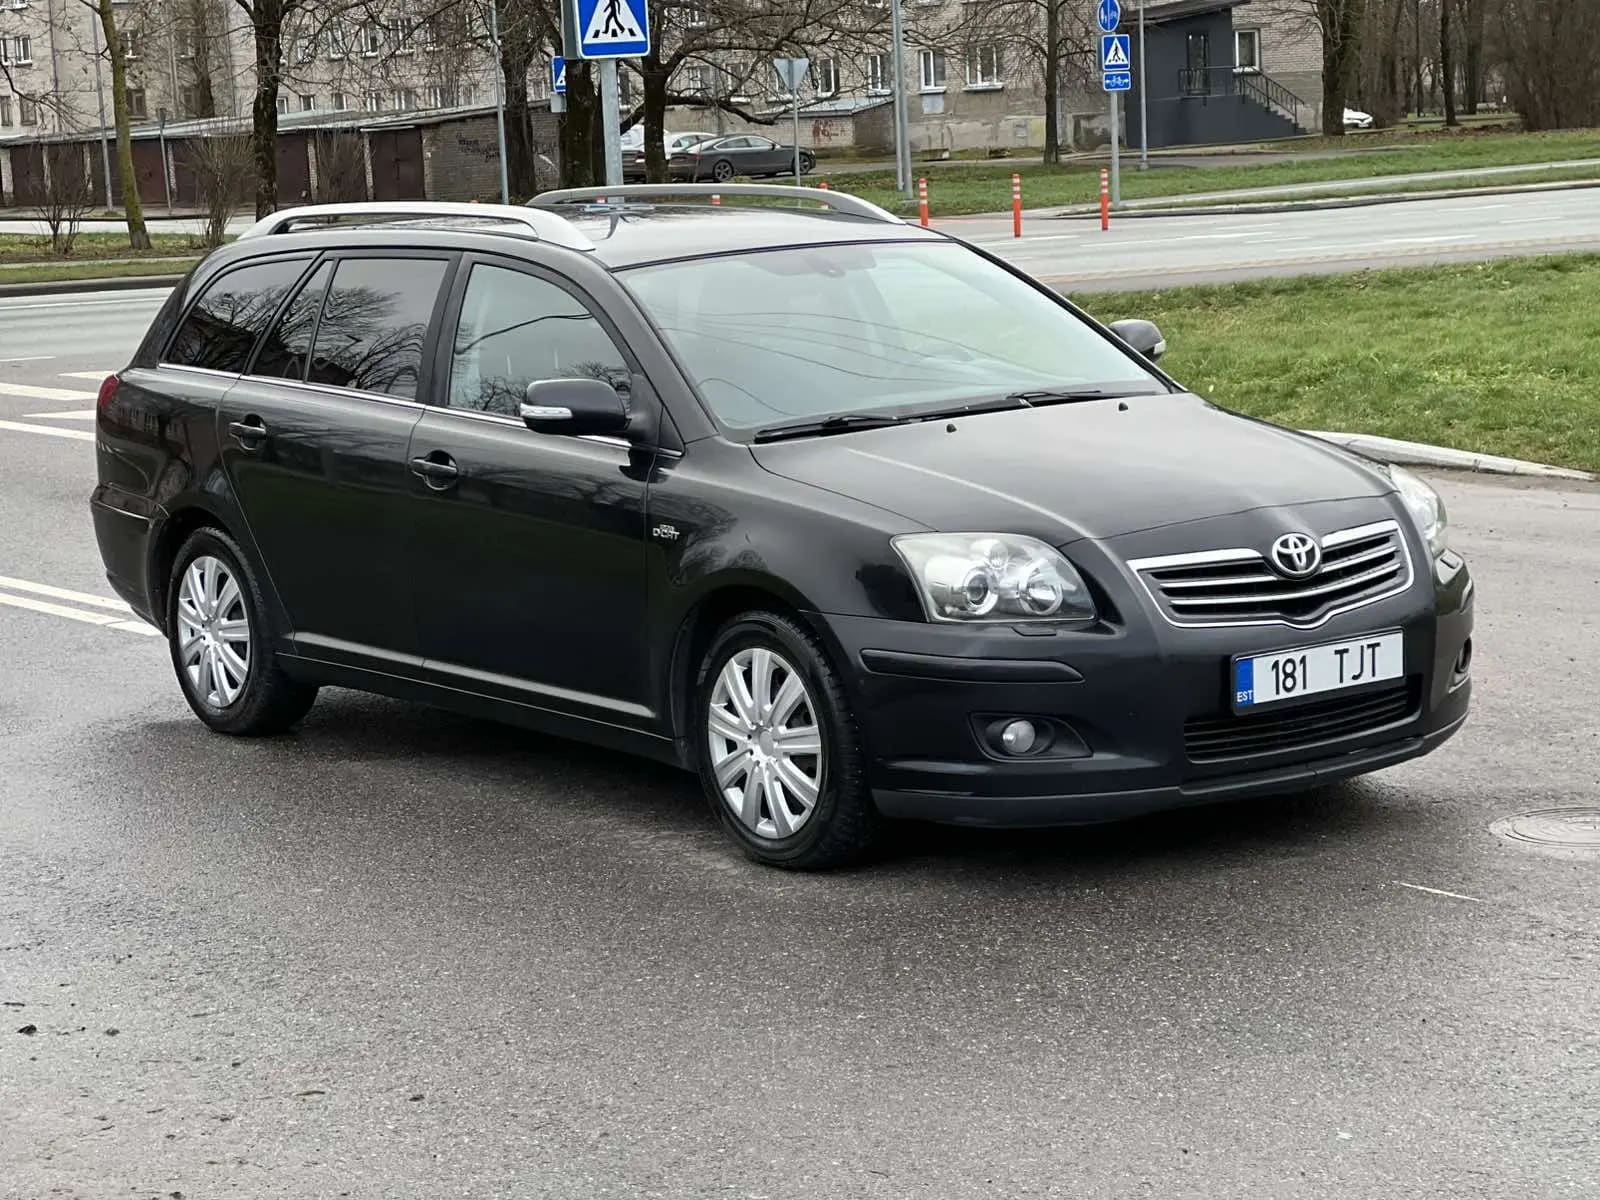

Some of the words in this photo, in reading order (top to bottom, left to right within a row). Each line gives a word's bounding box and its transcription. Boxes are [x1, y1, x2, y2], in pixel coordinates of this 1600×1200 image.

[1271, 655, 1307, 695] 181
[1334, 642, 1381, 684] TJT
[1236, 689, 1253, 702] EST
